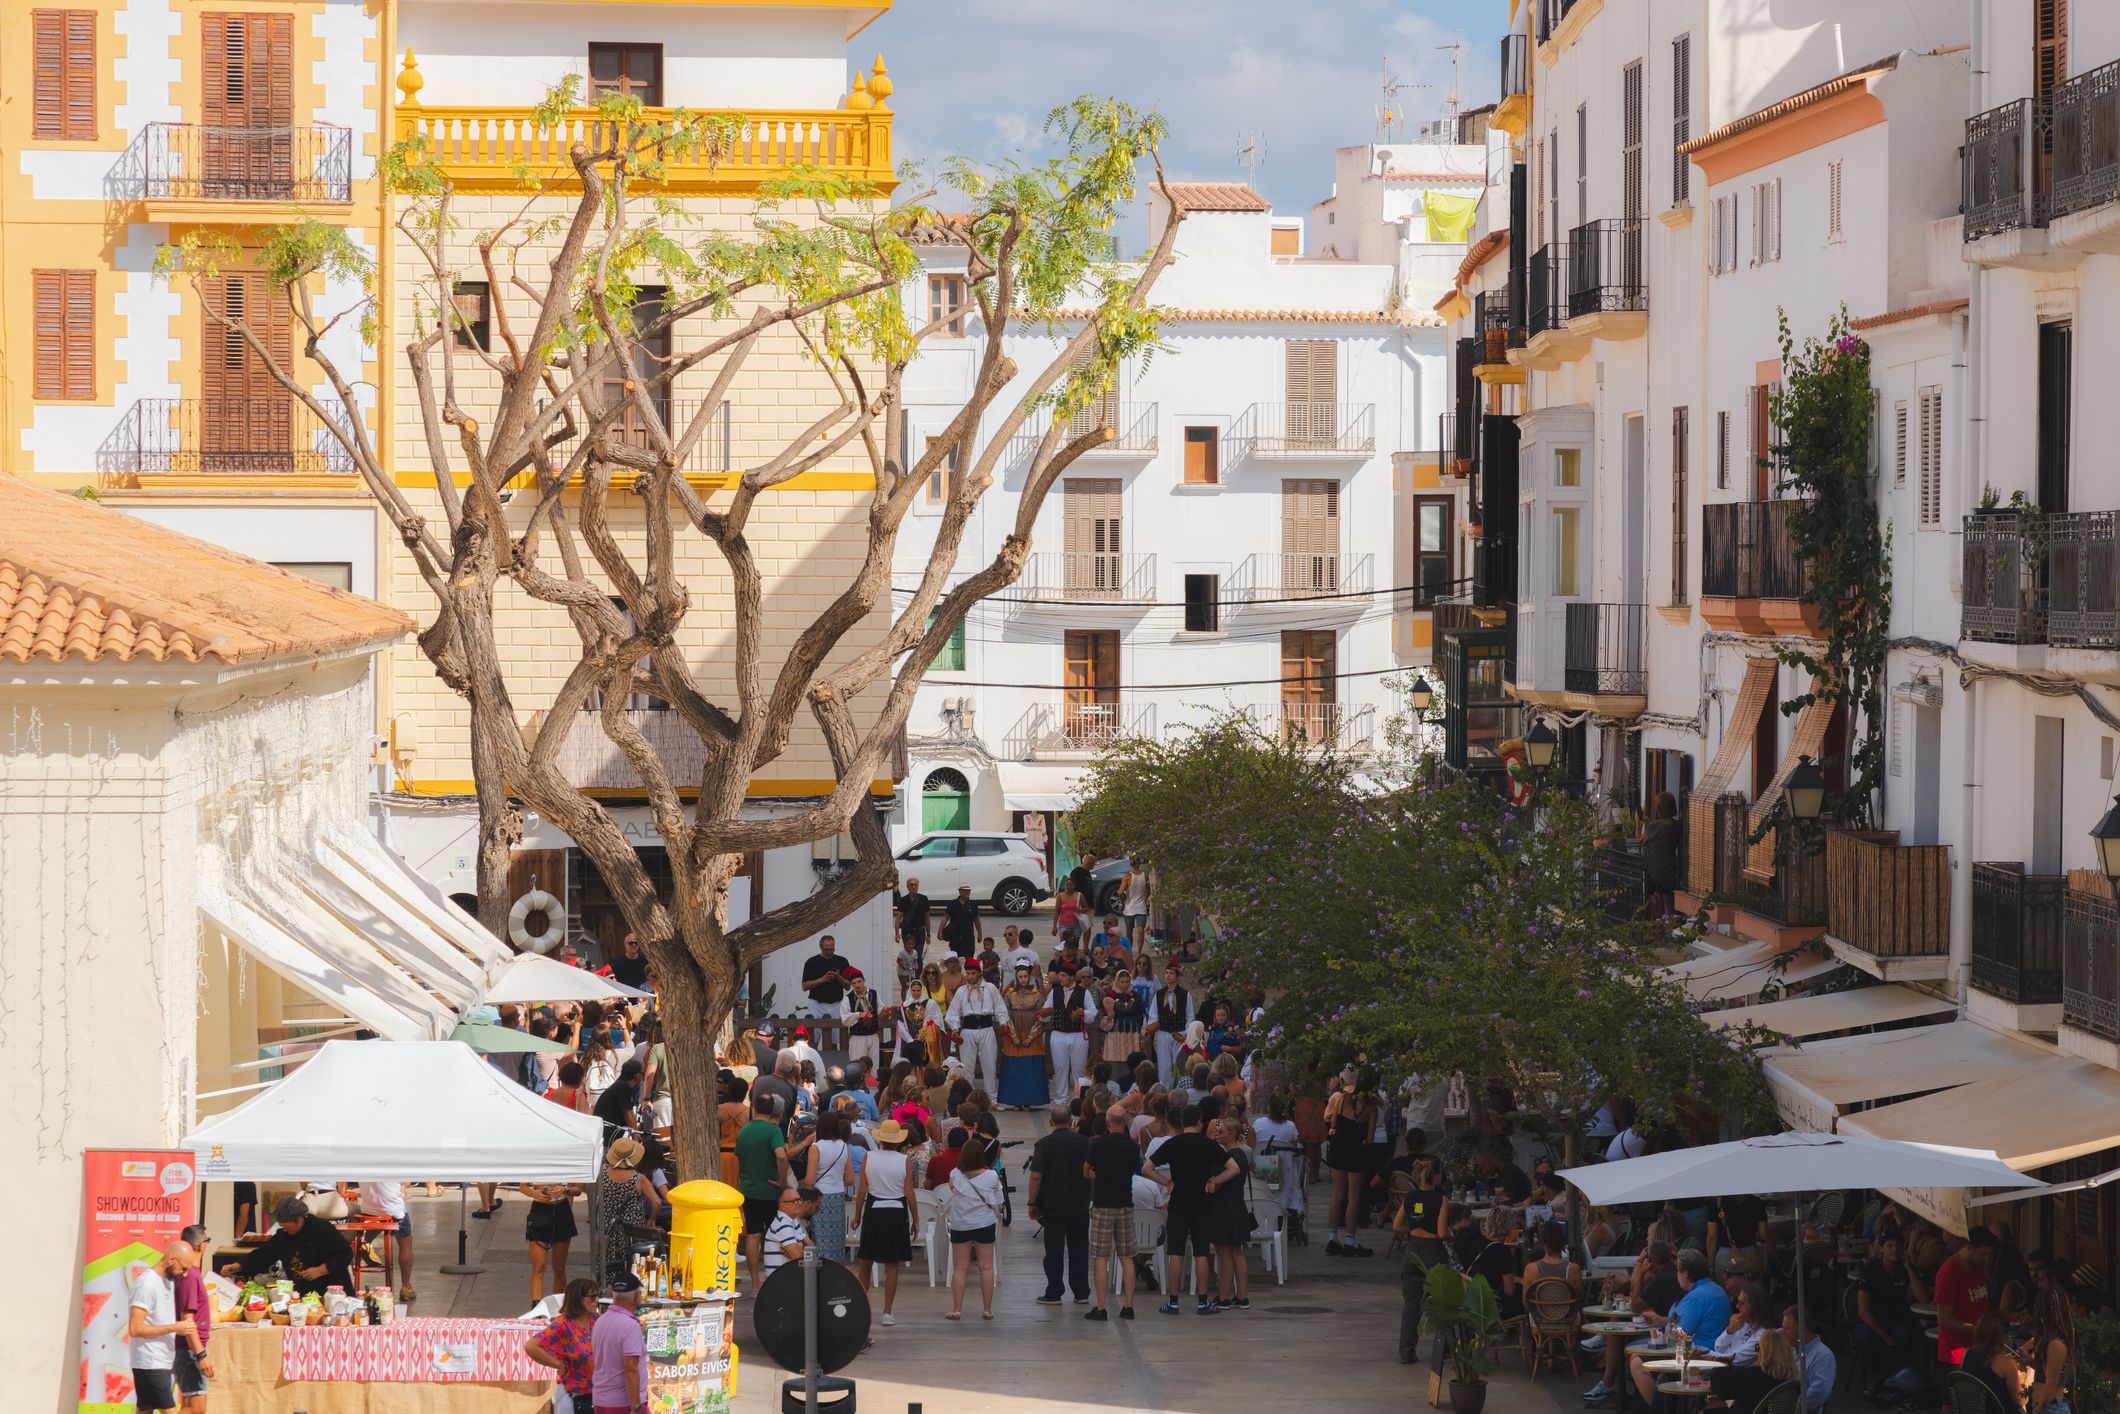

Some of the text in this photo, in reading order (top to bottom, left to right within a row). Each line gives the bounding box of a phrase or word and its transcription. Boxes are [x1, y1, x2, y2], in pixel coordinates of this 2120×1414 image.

[168, 1168, 183, 1176] Free
[96, 1196, 180, 1212] SHOWCOOKING
[654, 1363, 699, 1379] SABORS
